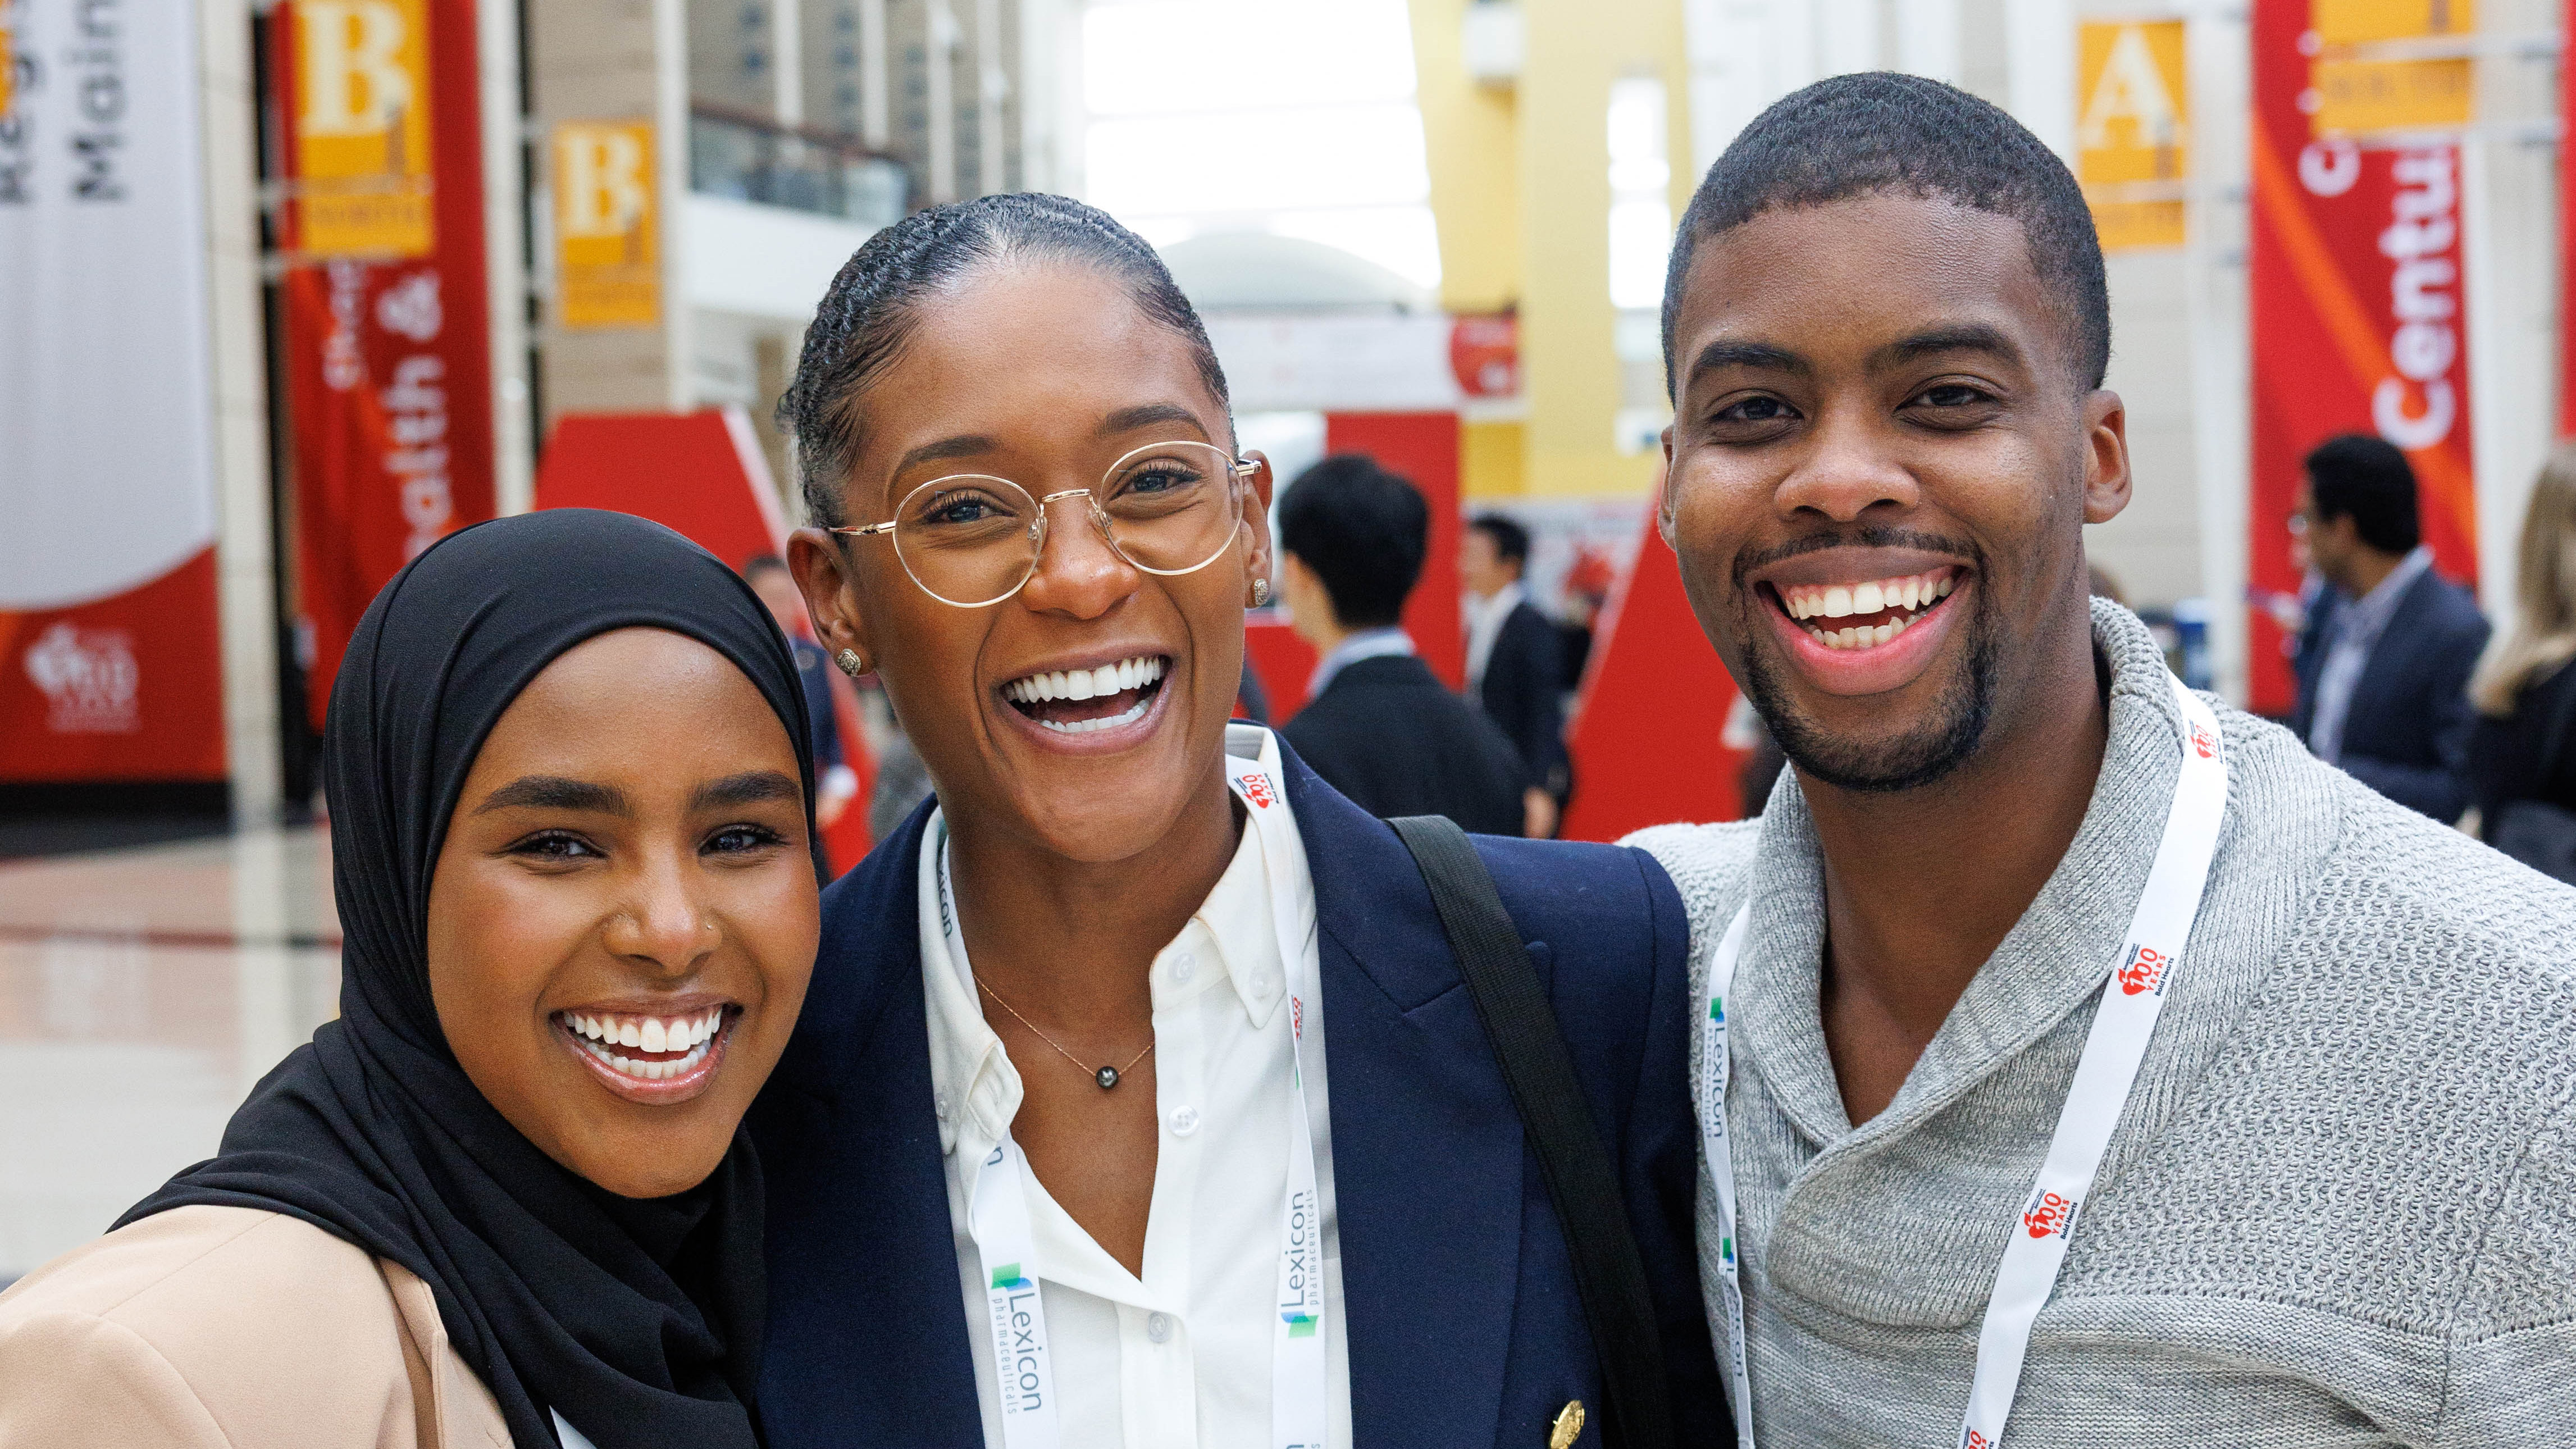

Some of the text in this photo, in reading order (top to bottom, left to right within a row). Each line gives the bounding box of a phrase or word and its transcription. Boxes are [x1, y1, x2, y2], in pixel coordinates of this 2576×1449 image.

[2130, 947, 2158, 987] 100
[2146, 954, 2166, 991] YEARS
[2155, 958, 2174, 996] Bold Hearts
[1713, 1027, 1725, 1137] Lexicon
[2035, 1193, 2062, 1229] 100
[2052, 1199, 2070, 1233] YEARS
[2060, 1202, 2078, 1240] Bold Hearts
[1281, 1192, 1305, 1307] Lexicon
[1306, 1190, 1320, 1306] pharmaceuticals
[992, 1297, 1019, 1414] pharmaceuticals
[1009, 1292, 1042, 1411] Lexicon
